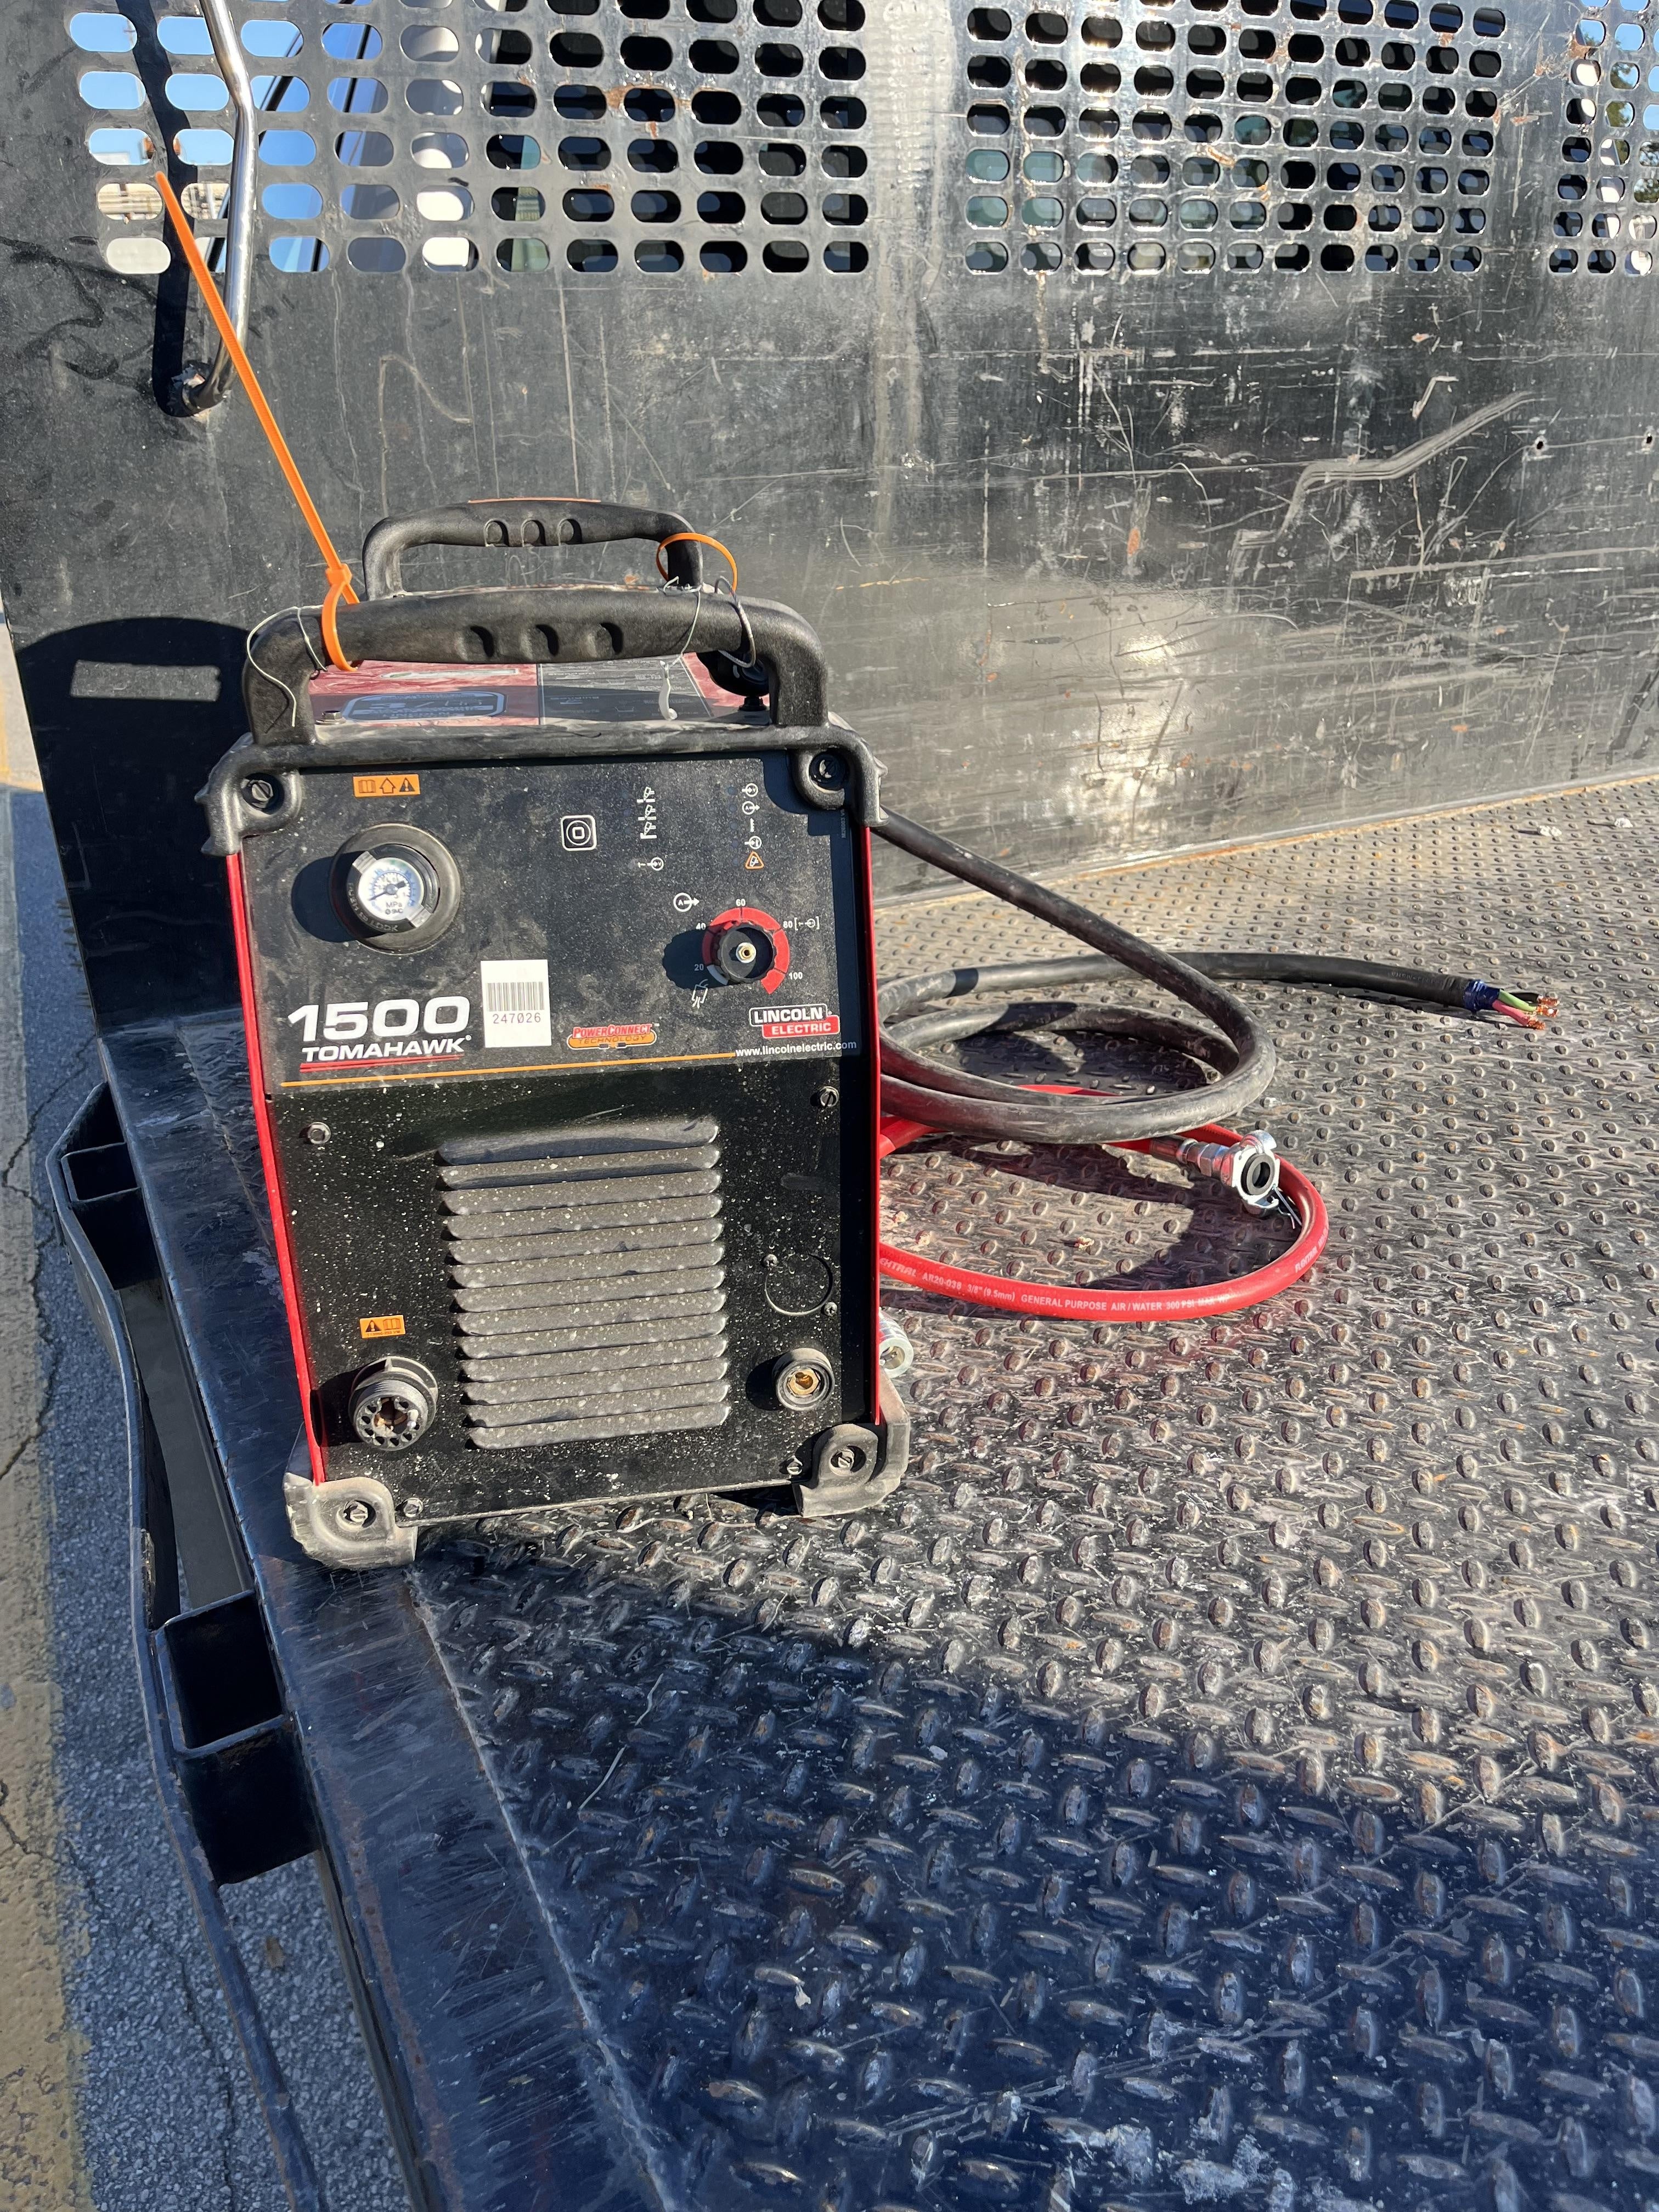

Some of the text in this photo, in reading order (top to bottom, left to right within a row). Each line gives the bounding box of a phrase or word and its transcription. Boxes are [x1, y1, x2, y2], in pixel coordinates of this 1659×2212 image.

[696, 922, 706, 930] 40
[783, 920, 793, 928] 80
[788, 972, 803, 980] 100
[287, 995, 470, 1042] 1500
[492, 1012, 541, 1024] 247026
[753, 1007, 824, 1024] LINCOLN
[771, 1023, 831, 1036] ELECTRIC
[578, 1035, 647, 1045] TECHNOLOGY
[301, 1037, 465, 1062] TOMAHAWK
[735, 1041, 857, 1057] www.lincolnelectric.com
[922, 1272, 962, 1290] AR20-038
[984, 1286, 1015, 1302] (9.5mm)
[1020, 1294, 1063, 1308] GENERAL
[1064, 1299, 1107, 1311] PURPOSE
[1166, 1300, 1180, 1310] 300
[1181, 1299, 1194, 1308] PSI
